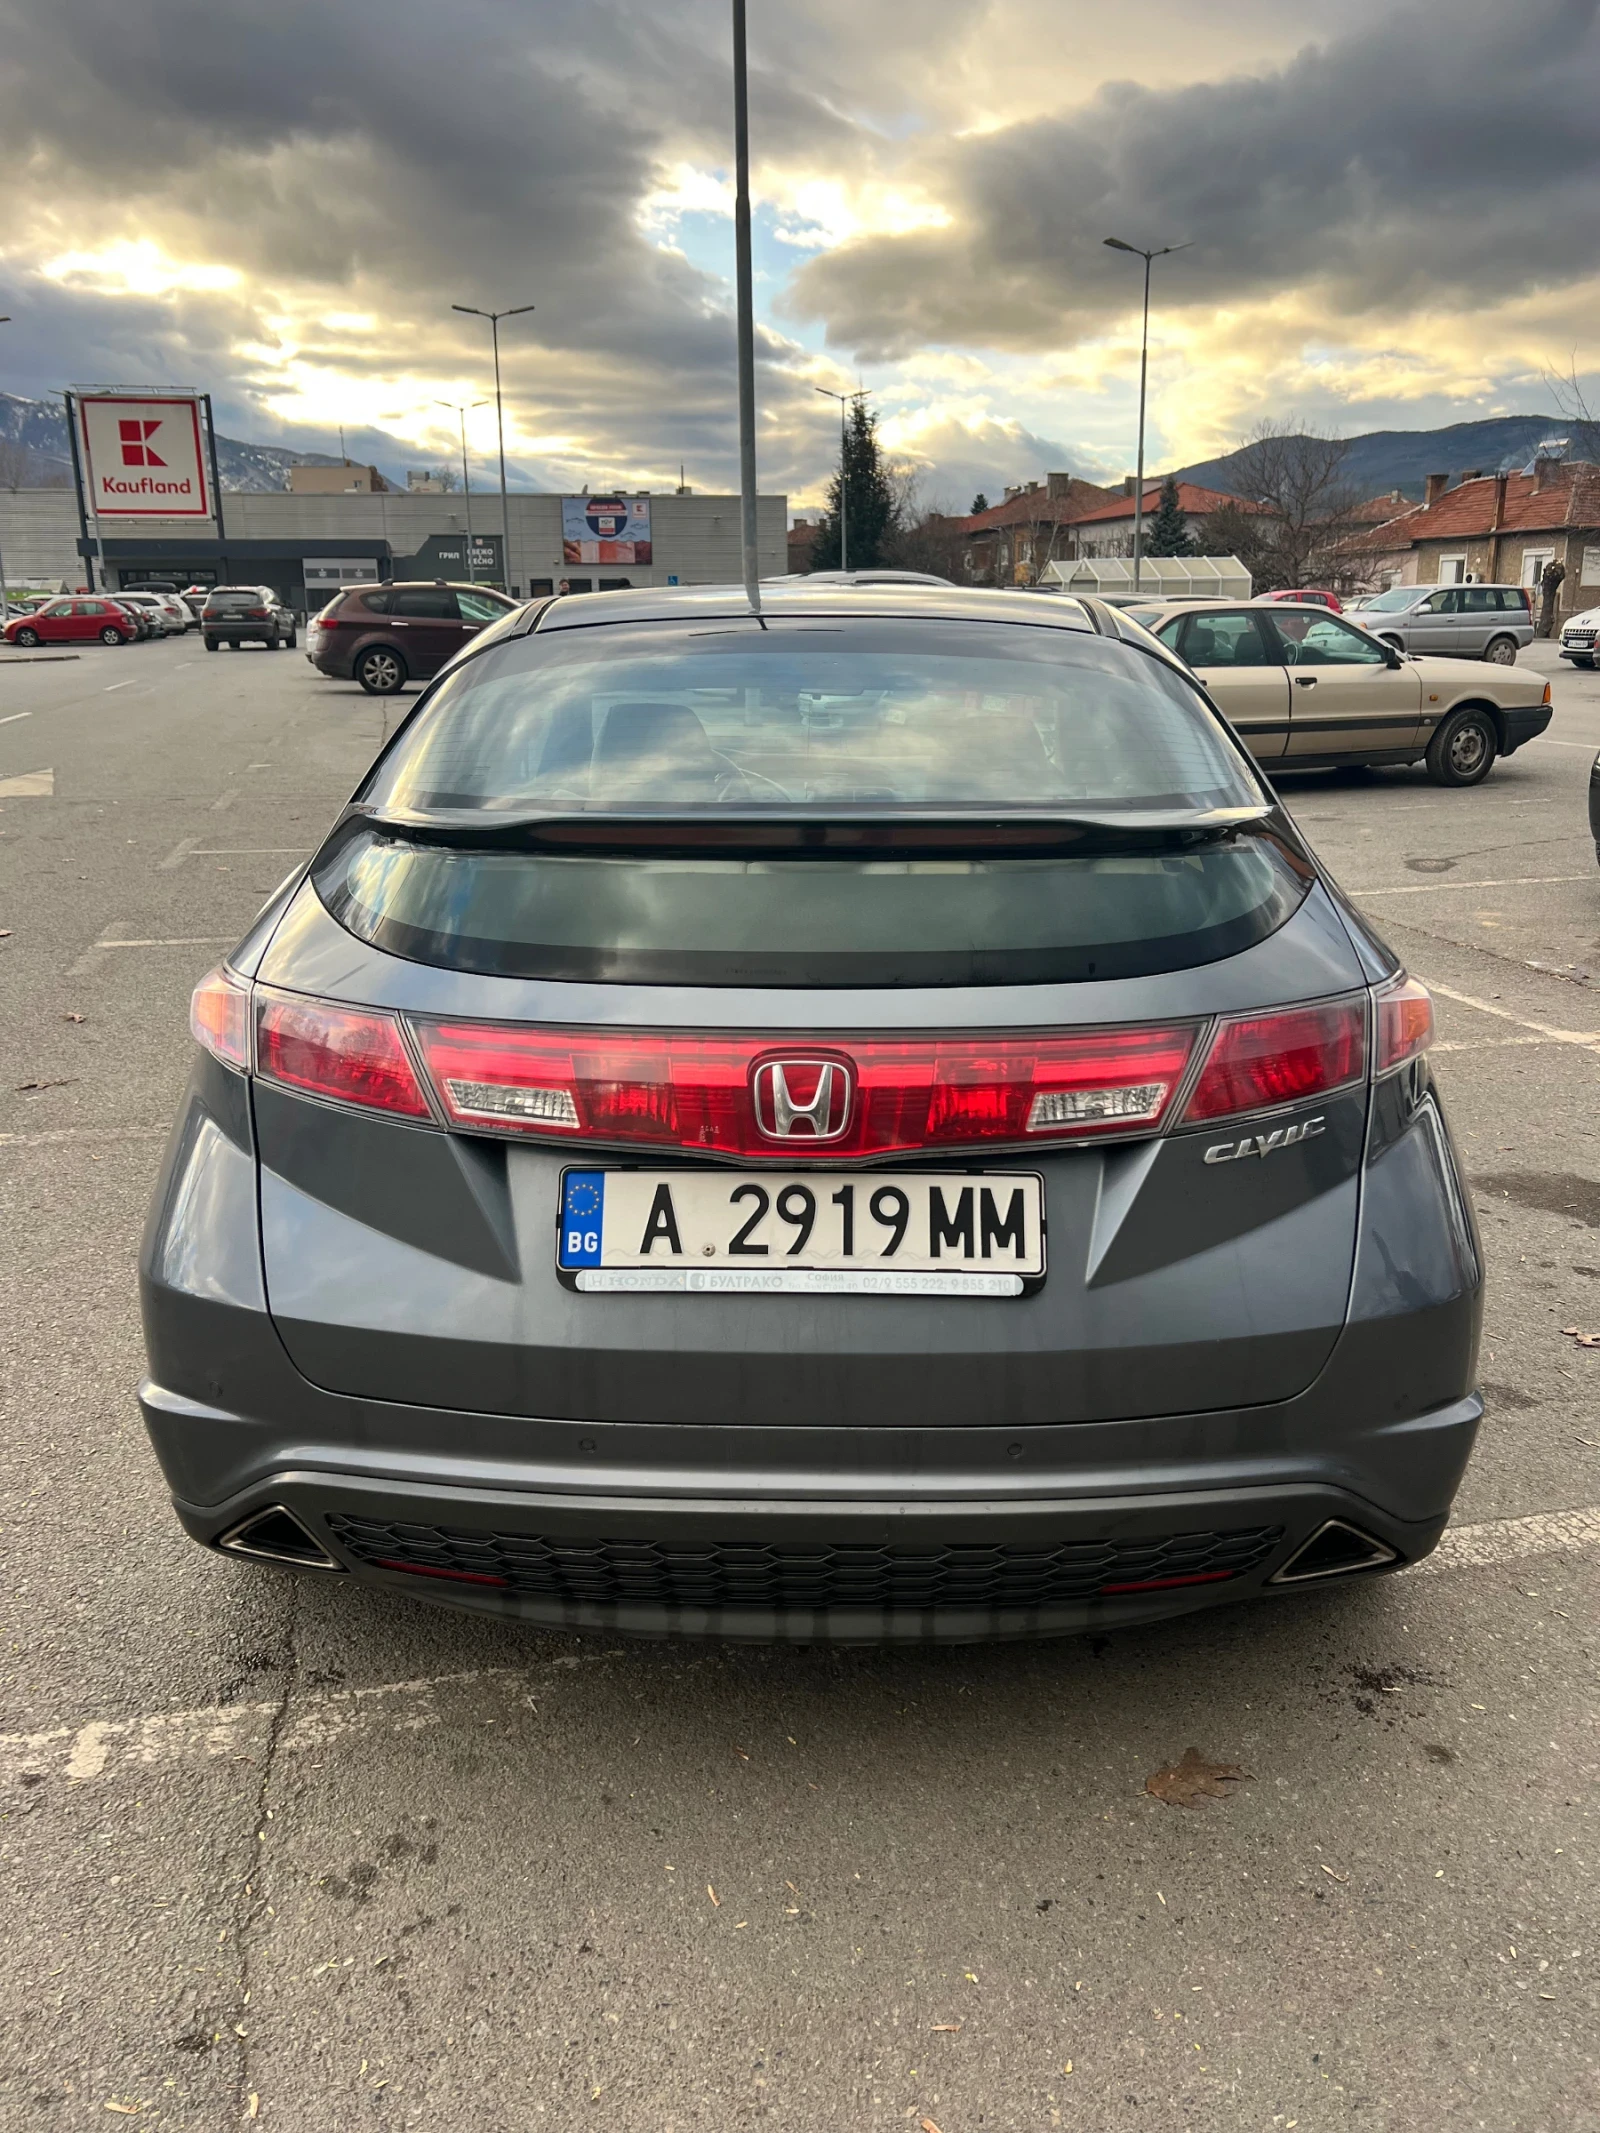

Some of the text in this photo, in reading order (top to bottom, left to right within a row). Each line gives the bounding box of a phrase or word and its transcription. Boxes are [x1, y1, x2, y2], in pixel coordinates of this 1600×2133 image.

[102, 477, 191, 494] Kaufland
[1203, 1116, 1326, 1165] CIVIC
[639, 1183, 1027, 1260] A 2919 MM
[567, 1231, 599, 1254] BG
[609, 1276, 682, 1287] HONDA
[710, 1276, 783, 1288] БУЛТРАКО
[863, 1276, 891, 1289] 02/9
[895, 1277, 917, 1289] 555
[963, 1279, 984, 1290] 555
[988, 1279, 1011, 1291] 210
